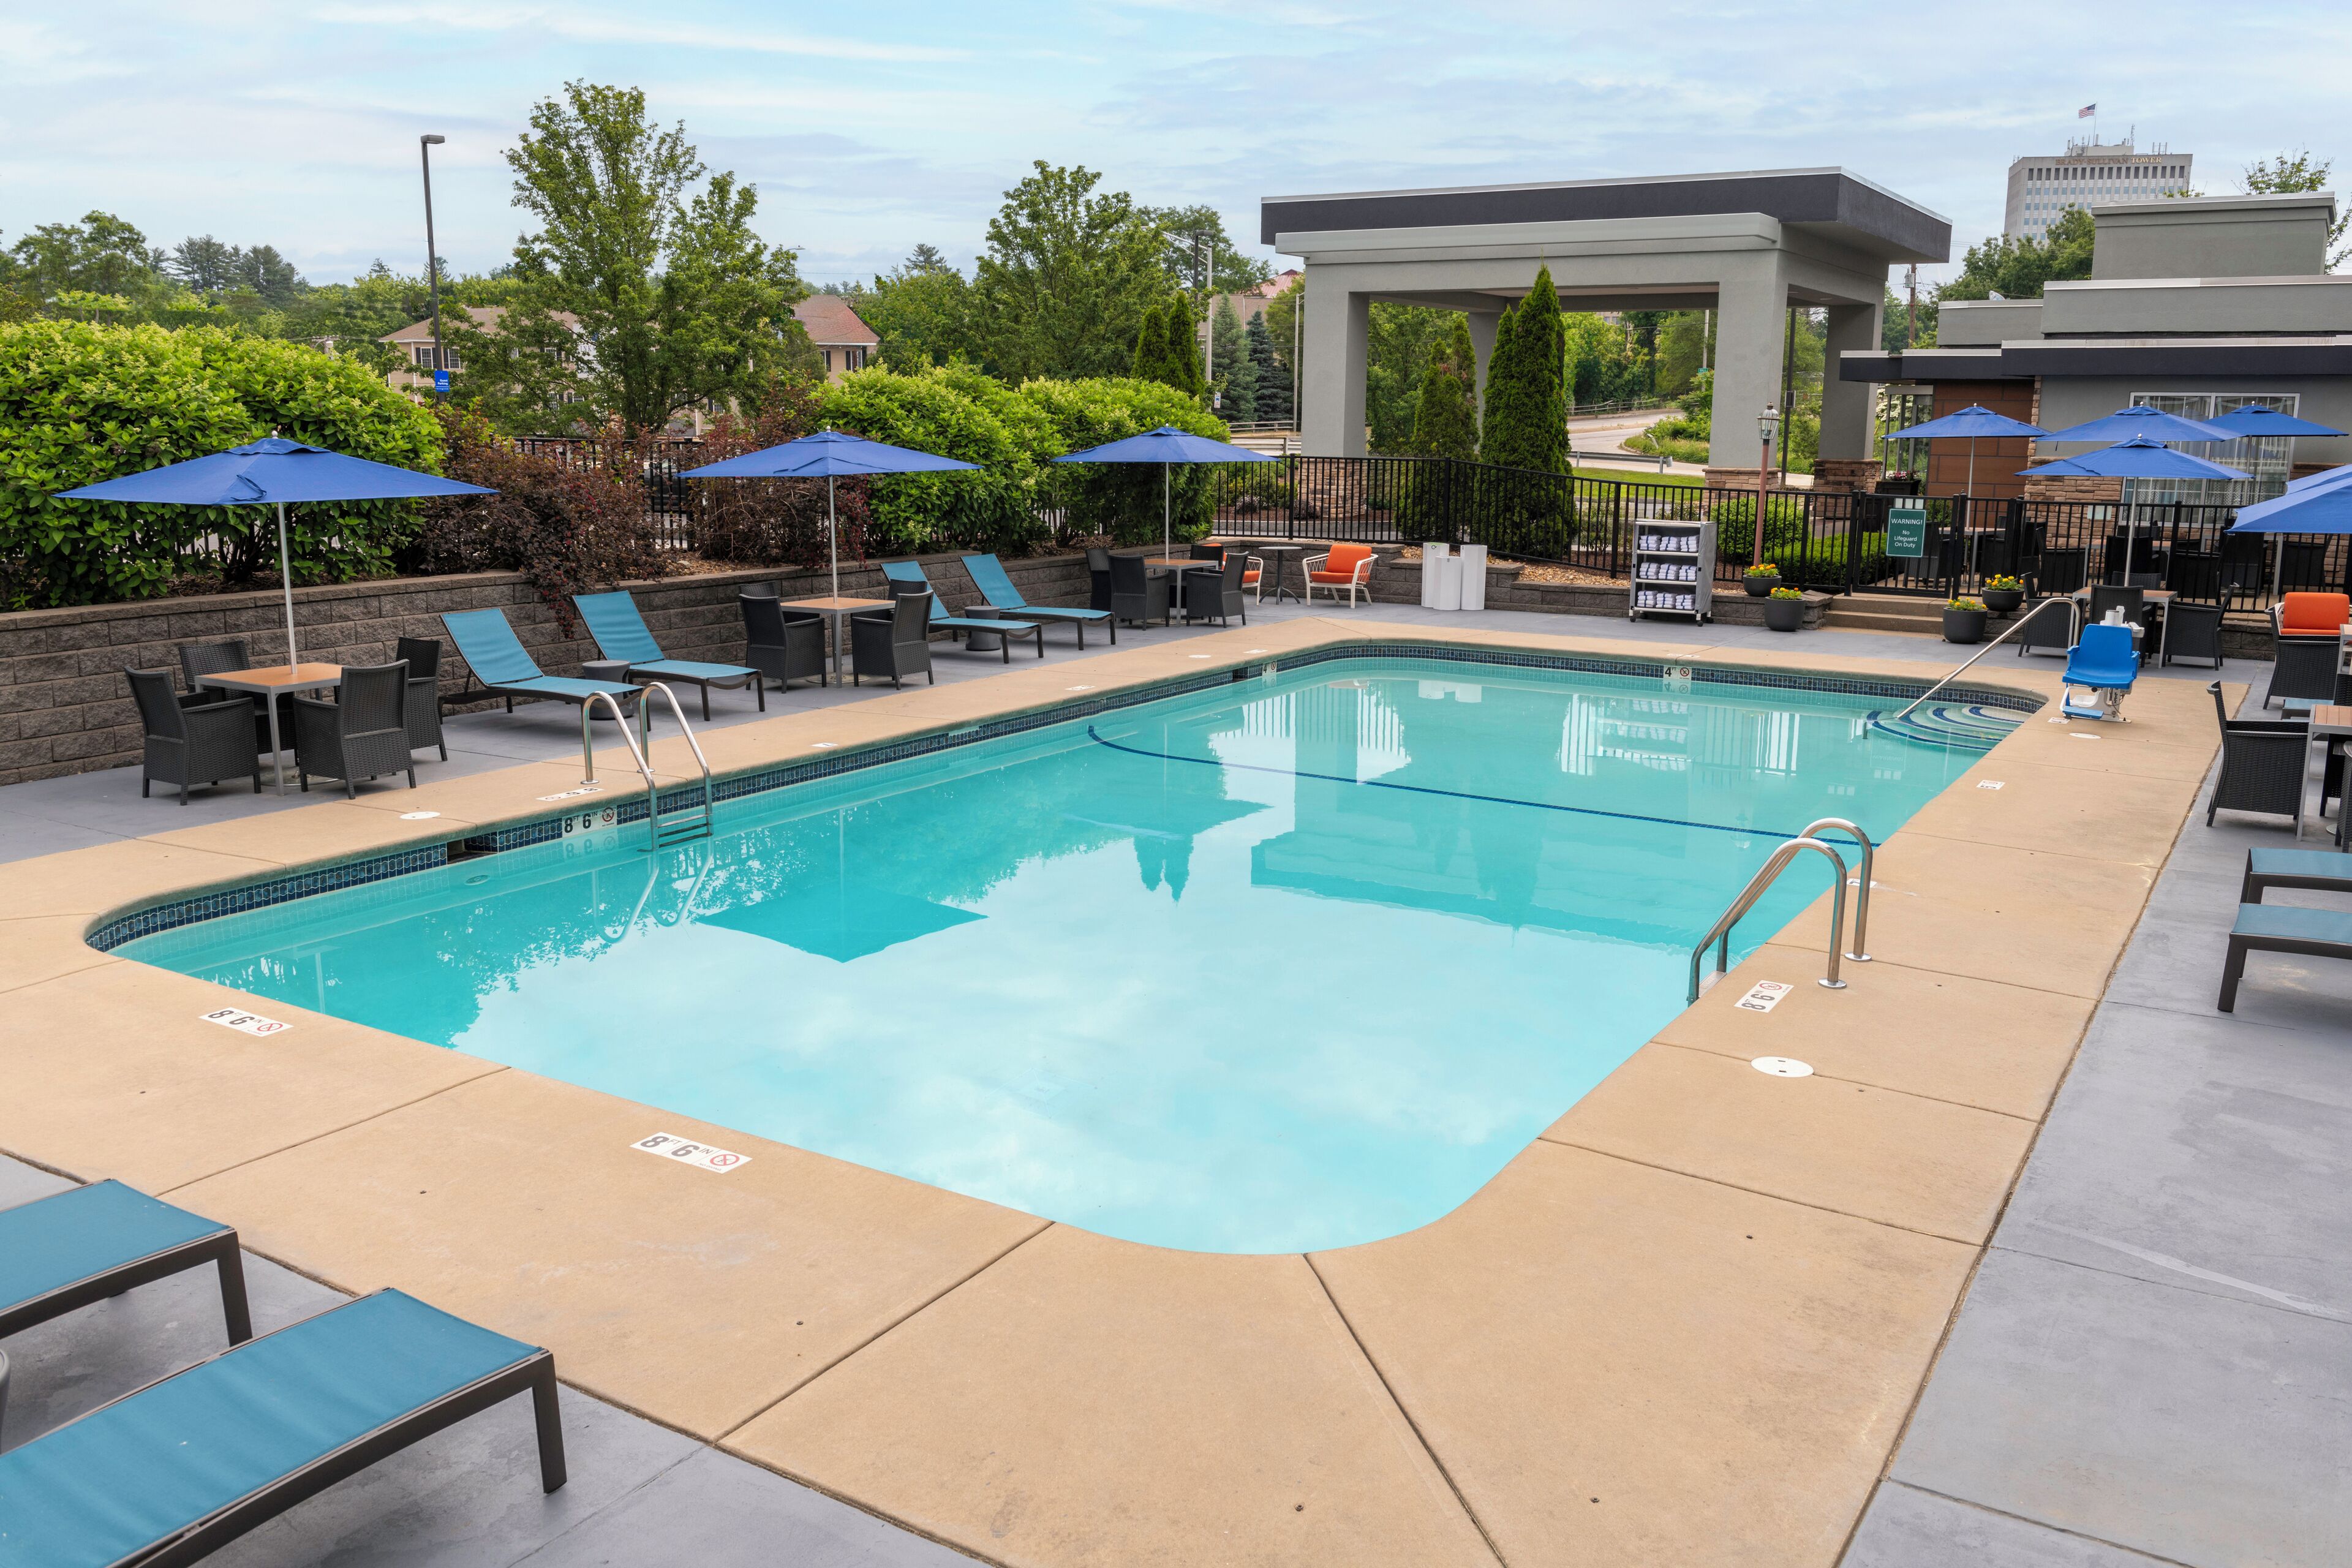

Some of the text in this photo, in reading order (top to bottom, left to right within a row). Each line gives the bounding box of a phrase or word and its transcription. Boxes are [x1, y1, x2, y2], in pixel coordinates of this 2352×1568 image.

[1665, 666, 1672, 677] 4
[565, 817, 573, 833] 8
[582, 813, 592, 829] 6
[229, 1016, 255, 1025] 6
[640, 1136, 669, 1148] 8
[671, 1144, 699, 1156] 6
